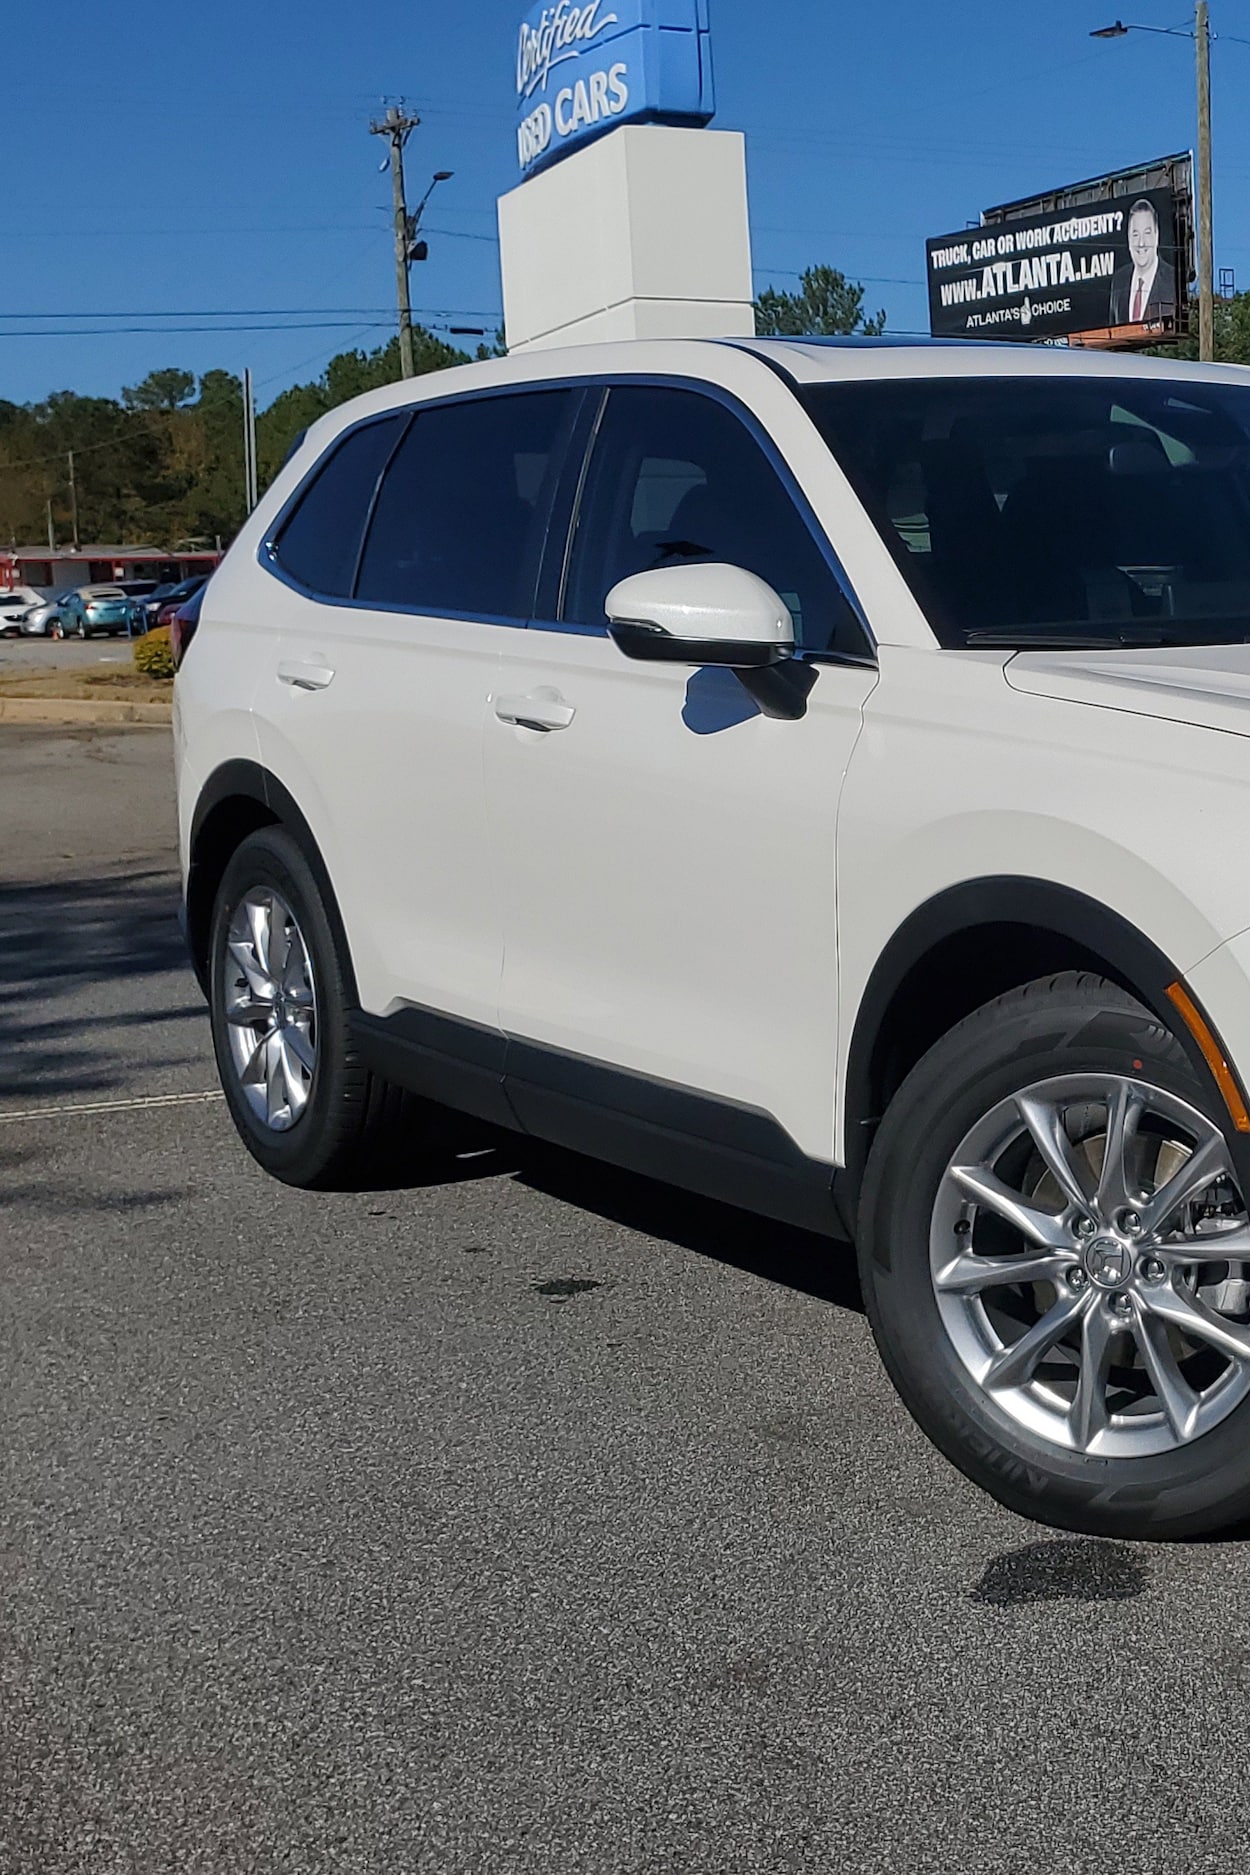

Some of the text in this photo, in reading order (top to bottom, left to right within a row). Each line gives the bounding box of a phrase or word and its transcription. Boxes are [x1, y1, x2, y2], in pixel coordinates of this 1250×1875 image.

[555, 63, 628, 136] CARS
[931, 211, 1124, 270] TRUCK, CAR OR WORK ACCIDENT?
[966, 298, 1072, 329] ATLANTA'S CHOICE
